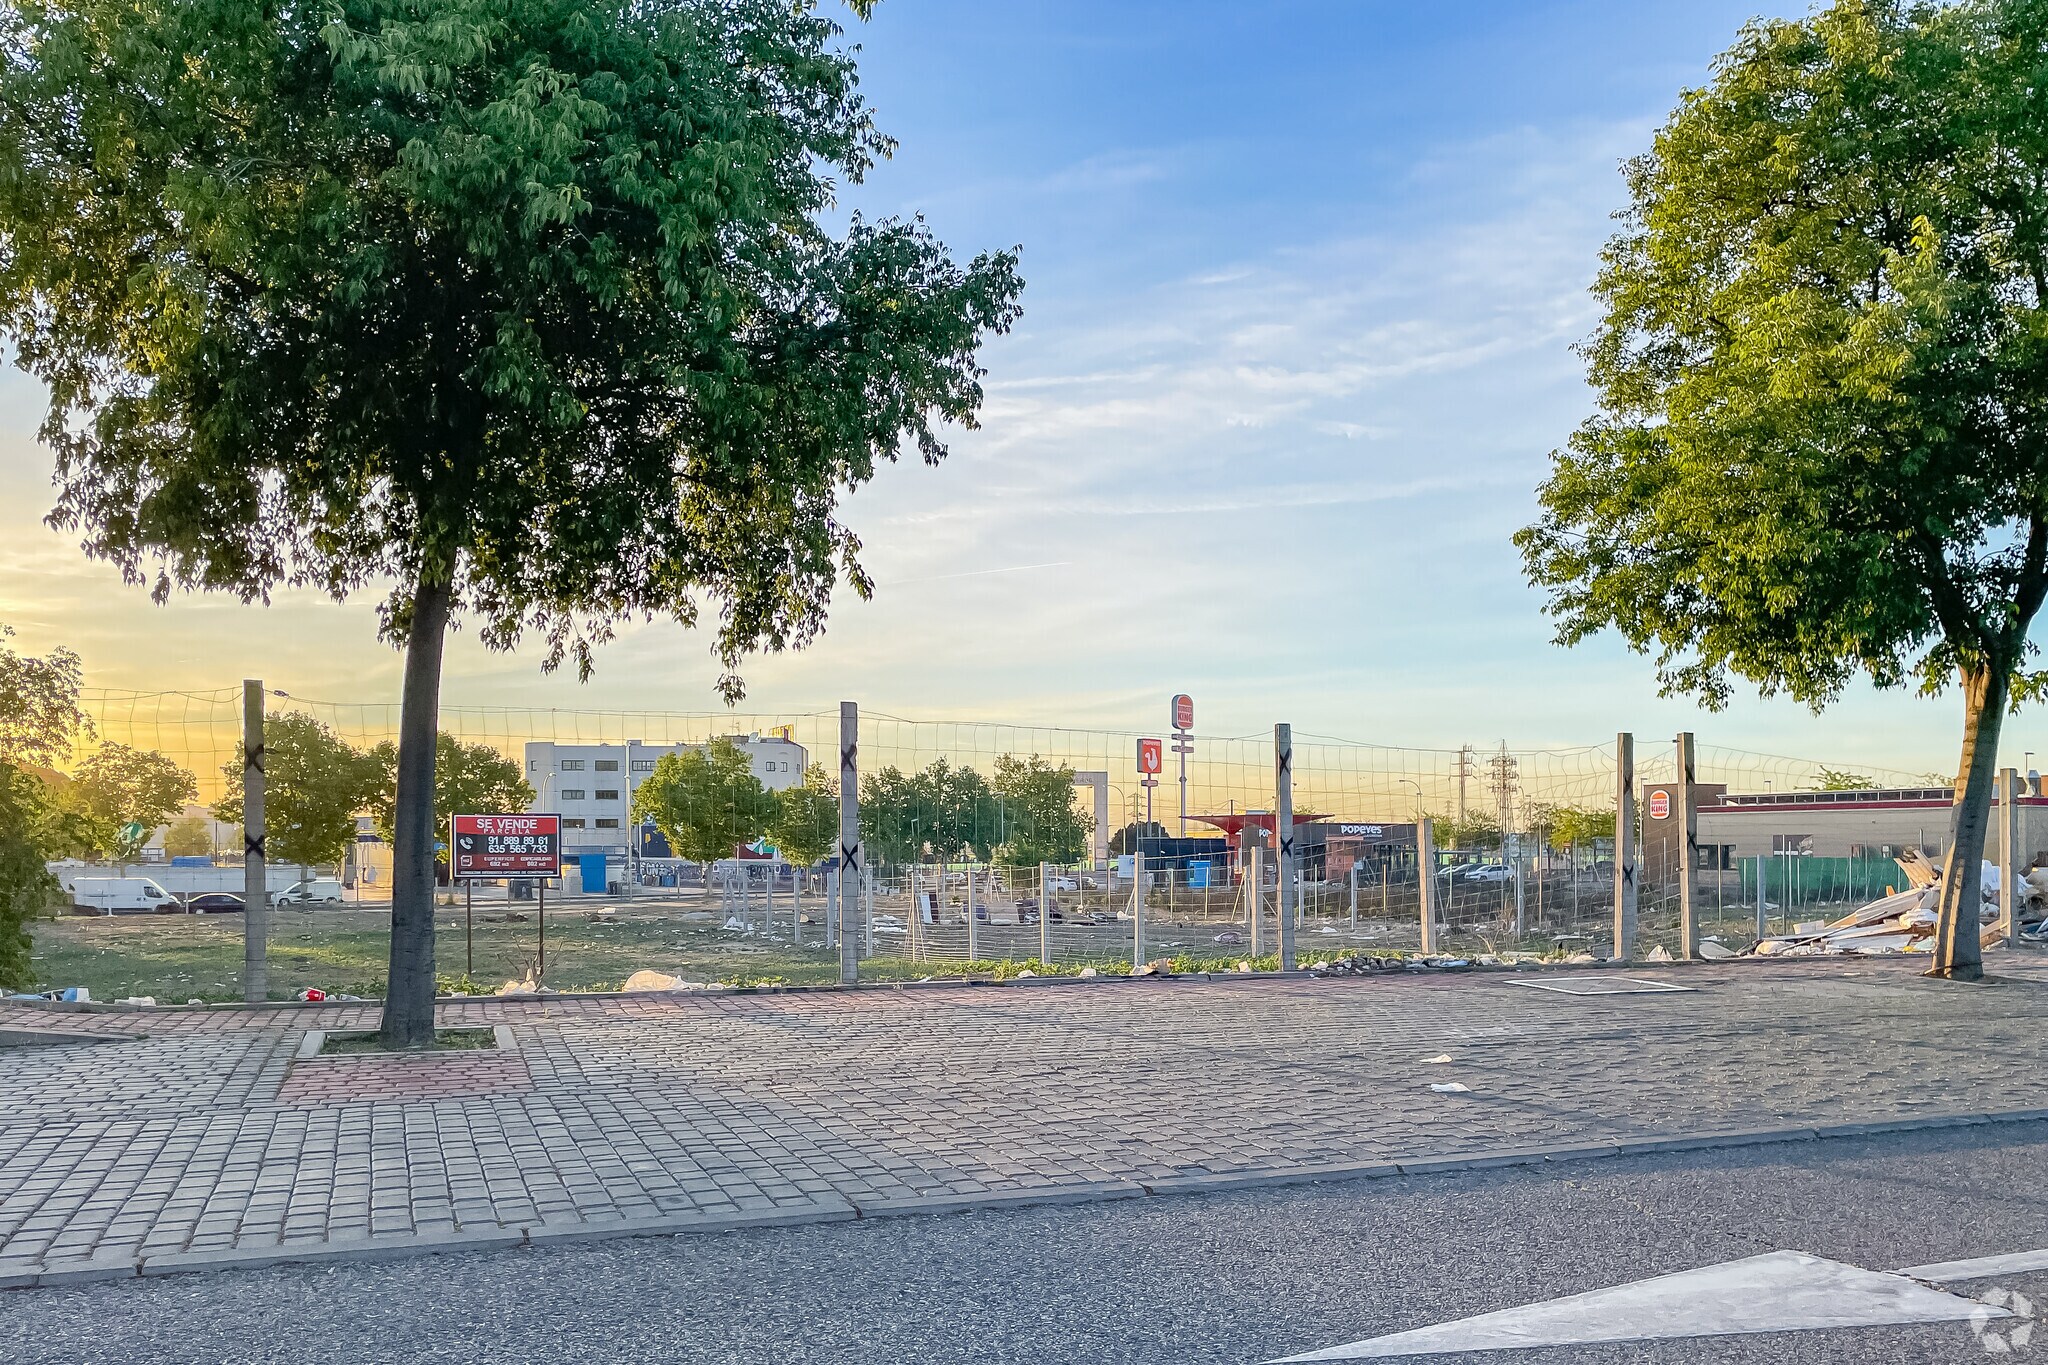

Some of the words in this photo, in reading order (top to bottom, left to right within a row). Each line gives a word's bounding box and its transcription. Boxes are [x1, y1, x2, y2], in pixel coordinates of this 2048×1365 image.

[476, 819, 492, 829] SE
[497, 819, 537, 829] VENDE
[1340, 825, 1382, 834] POPEYES
[488, 836, 499, 845] 91
[503, 836, 519, 845] 889
[523, 836, 534, 845] 89
[538, 836, 548, 845] 61
[488, 845, 506, 853] 635
[509, 845, 527, 853] 565
[531, 845, 548, 853] 733
